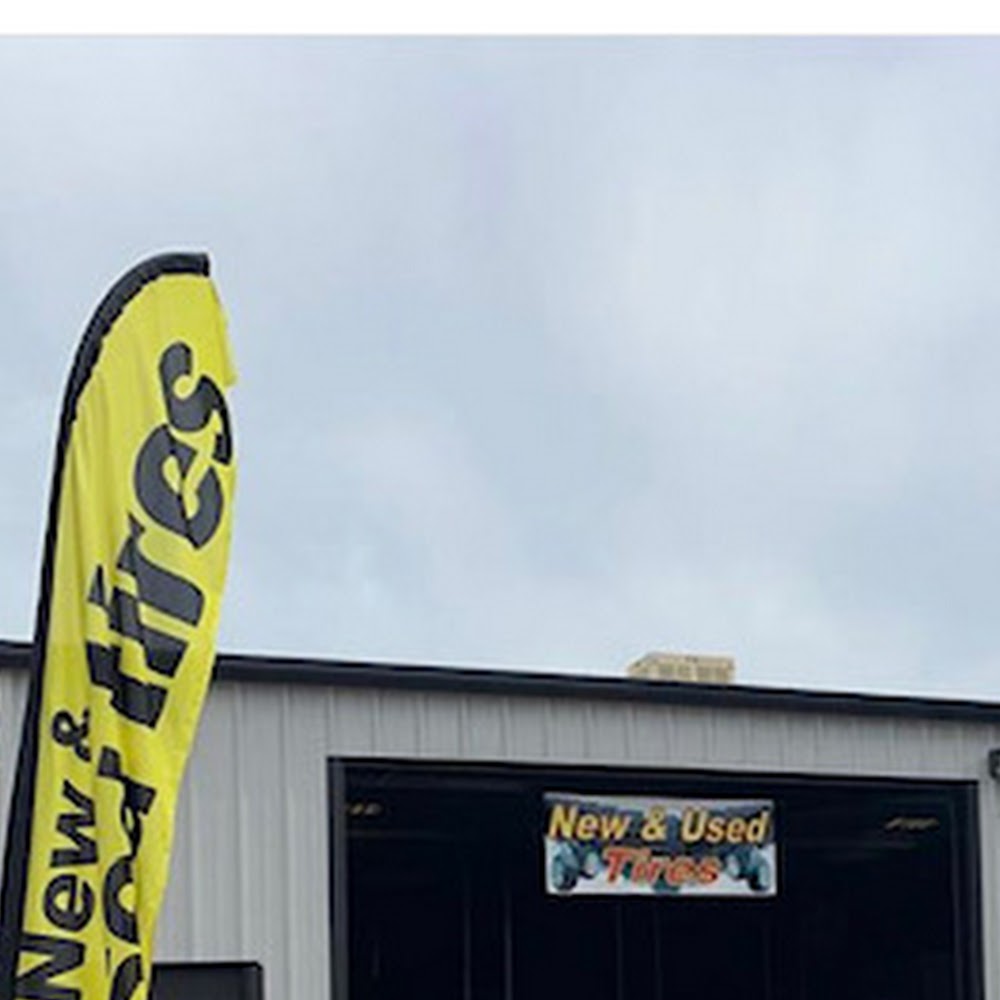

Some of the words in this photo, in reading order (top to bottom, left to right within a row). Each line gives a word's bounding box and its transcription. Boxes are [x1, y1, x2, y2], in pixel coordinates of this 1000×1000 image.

[87, 341, 233, 729] tires
[51, 708, 91, 762] &
[549, 803, 630, 841] New
[641, 805, 667, 843] &
[680, 807, 770, 844] Used
[603, 847, 722, 886] Tires
